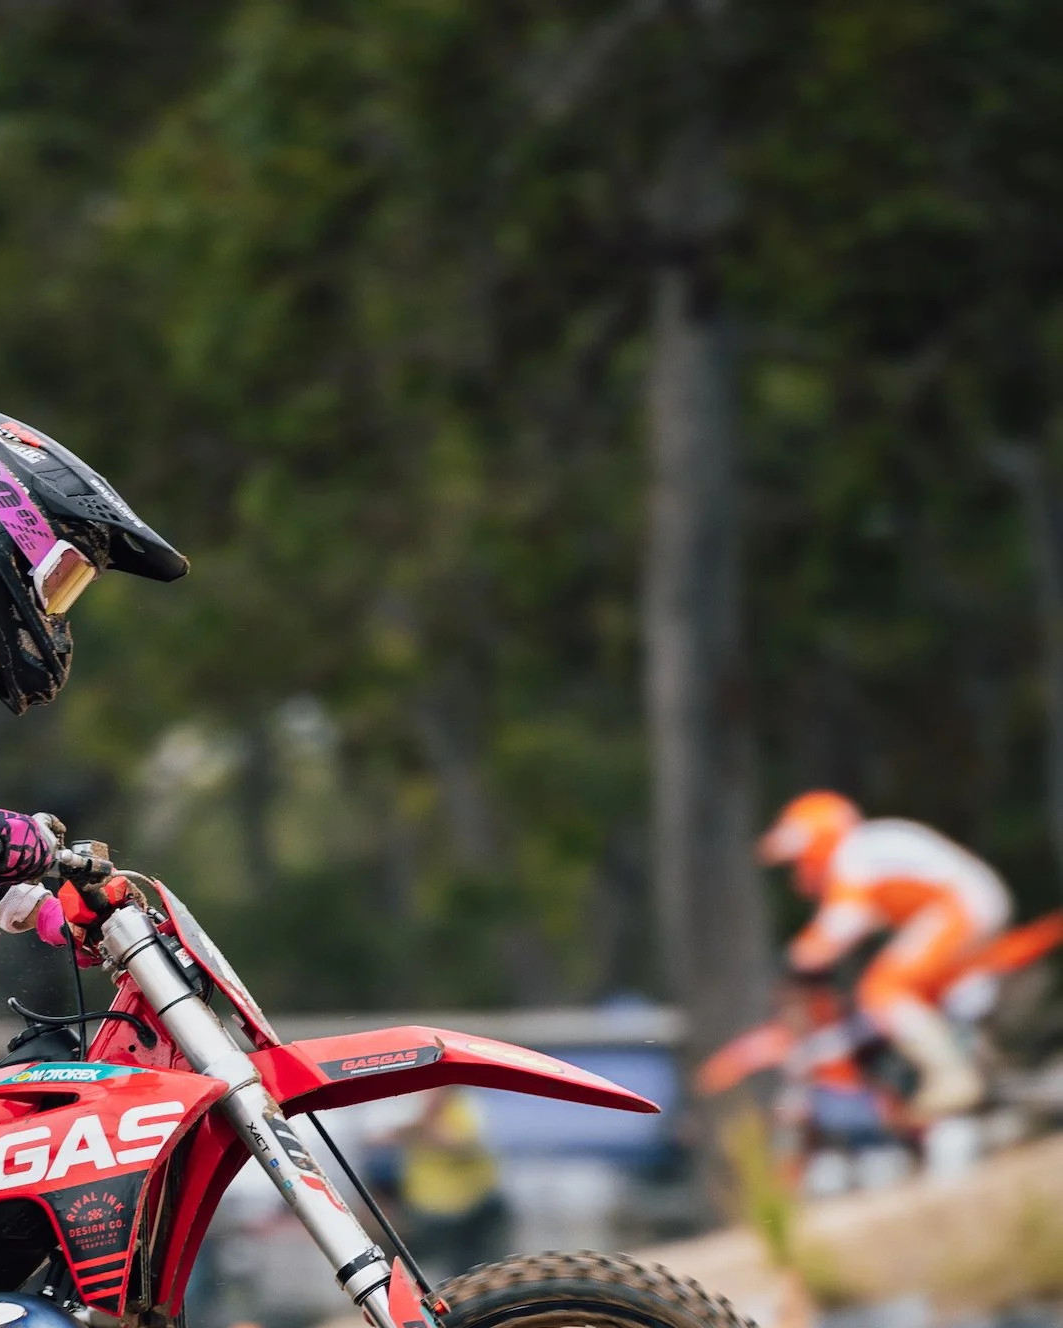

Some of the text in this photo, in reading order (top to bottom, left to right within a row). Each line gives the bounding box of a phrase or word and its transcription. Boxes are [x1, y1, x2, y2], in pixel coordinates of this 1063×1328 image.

[341, 1050, 418, 1071] GASGAS
[29, 1068, 102, 1081] MOTOREX
[246, 1121, 271, 1152] XACT
[66, 1191, 125, 1222] RIVAL INK
[69, 1219, 126, 1238] DESIGN CO.
